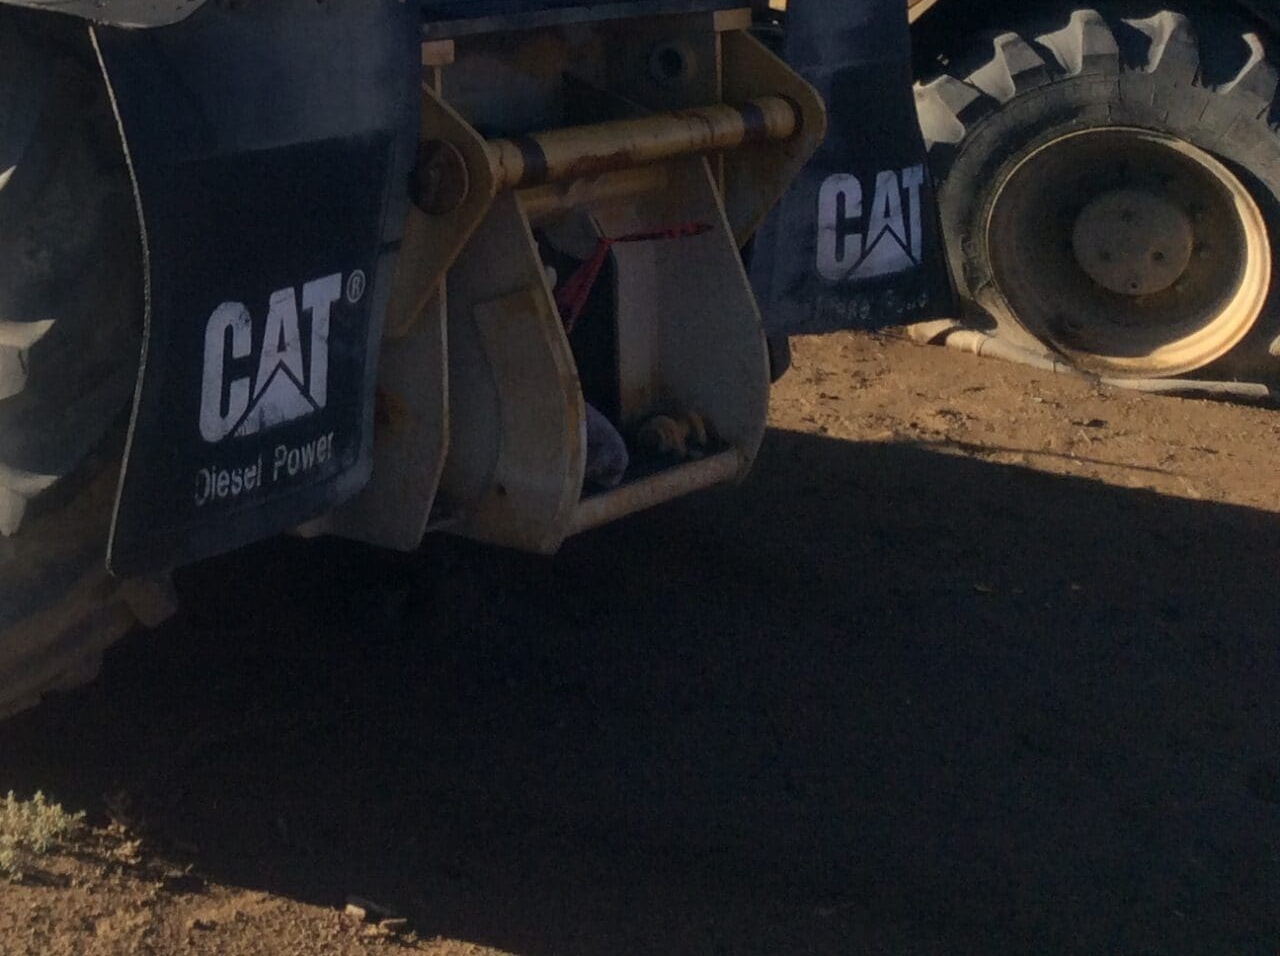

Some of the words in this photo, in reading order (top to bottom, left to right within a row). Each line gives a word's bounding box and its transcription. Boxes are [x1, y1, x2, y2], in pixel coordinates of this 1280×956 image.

[816, 163, 924, 281] CAT
[195, 452, 263, 507] Diesel
[272, 431, 335, 482] Power
